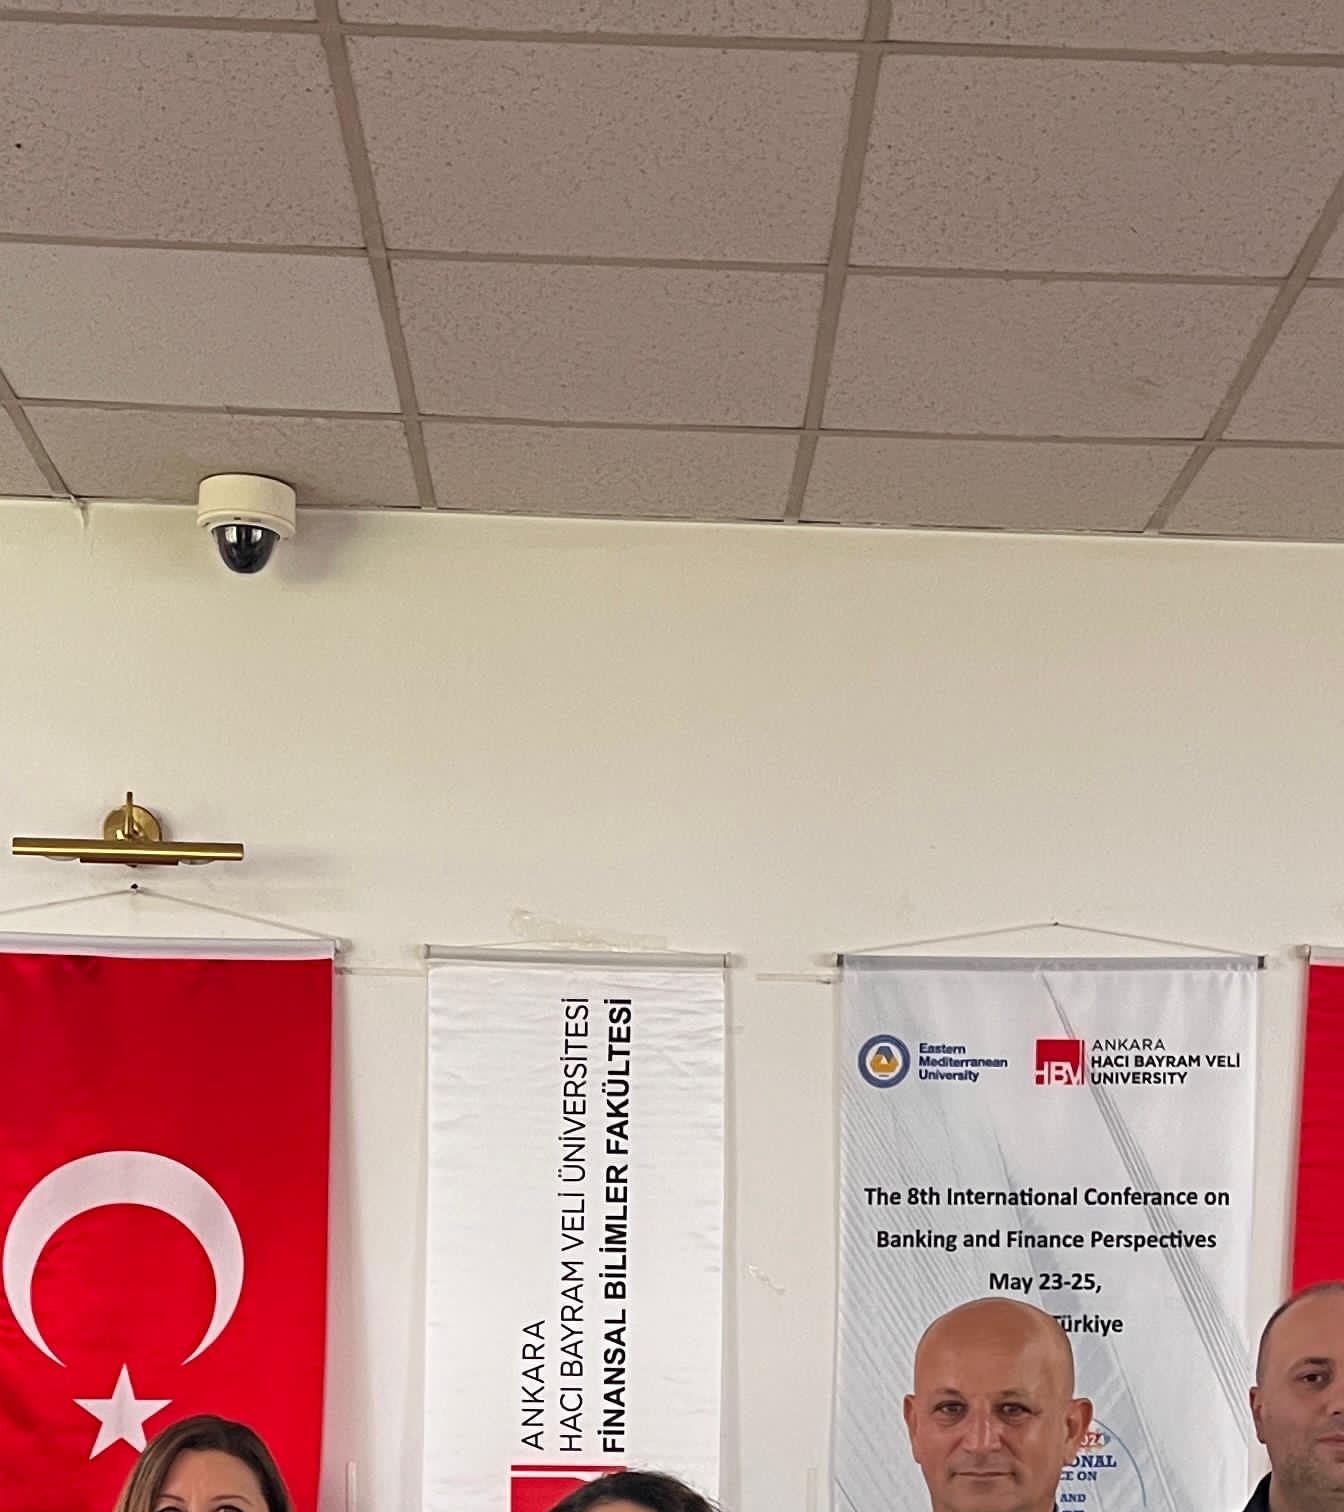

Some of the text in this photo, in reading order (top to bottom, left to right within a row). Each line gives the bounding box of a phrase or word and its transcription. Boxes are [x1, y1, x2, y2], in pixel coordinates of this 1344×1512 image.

[918, 1042, 966, 1054] Eastern
[1092, 1039, 1166, 1051] ANKARA
[918, 1056, 1008, 1067] Mediterranean
[1091, 1053, 1241, 1068] HACI BAYRAM VELİ
[918, 1069, 980, 1083] University
[1091, 1072, 1188, 1085] UNIVERSITY
[864, 1187, 1230, 1207] The 8th International Conferance on
[558, 998, 589, 1452] HACI BAYRAM VELİ ÜNİVERSİTESİ
[597, 998, 632, 1453] FİNANSAL BİLİMLER FAKÜLTESİ
[877, 1230, 1217, 1254] Banking and Finance Perspectives
[989, 1273, 1102, 1294] May 23-25,
[521, 1319, 545, 1451] ANKARA
